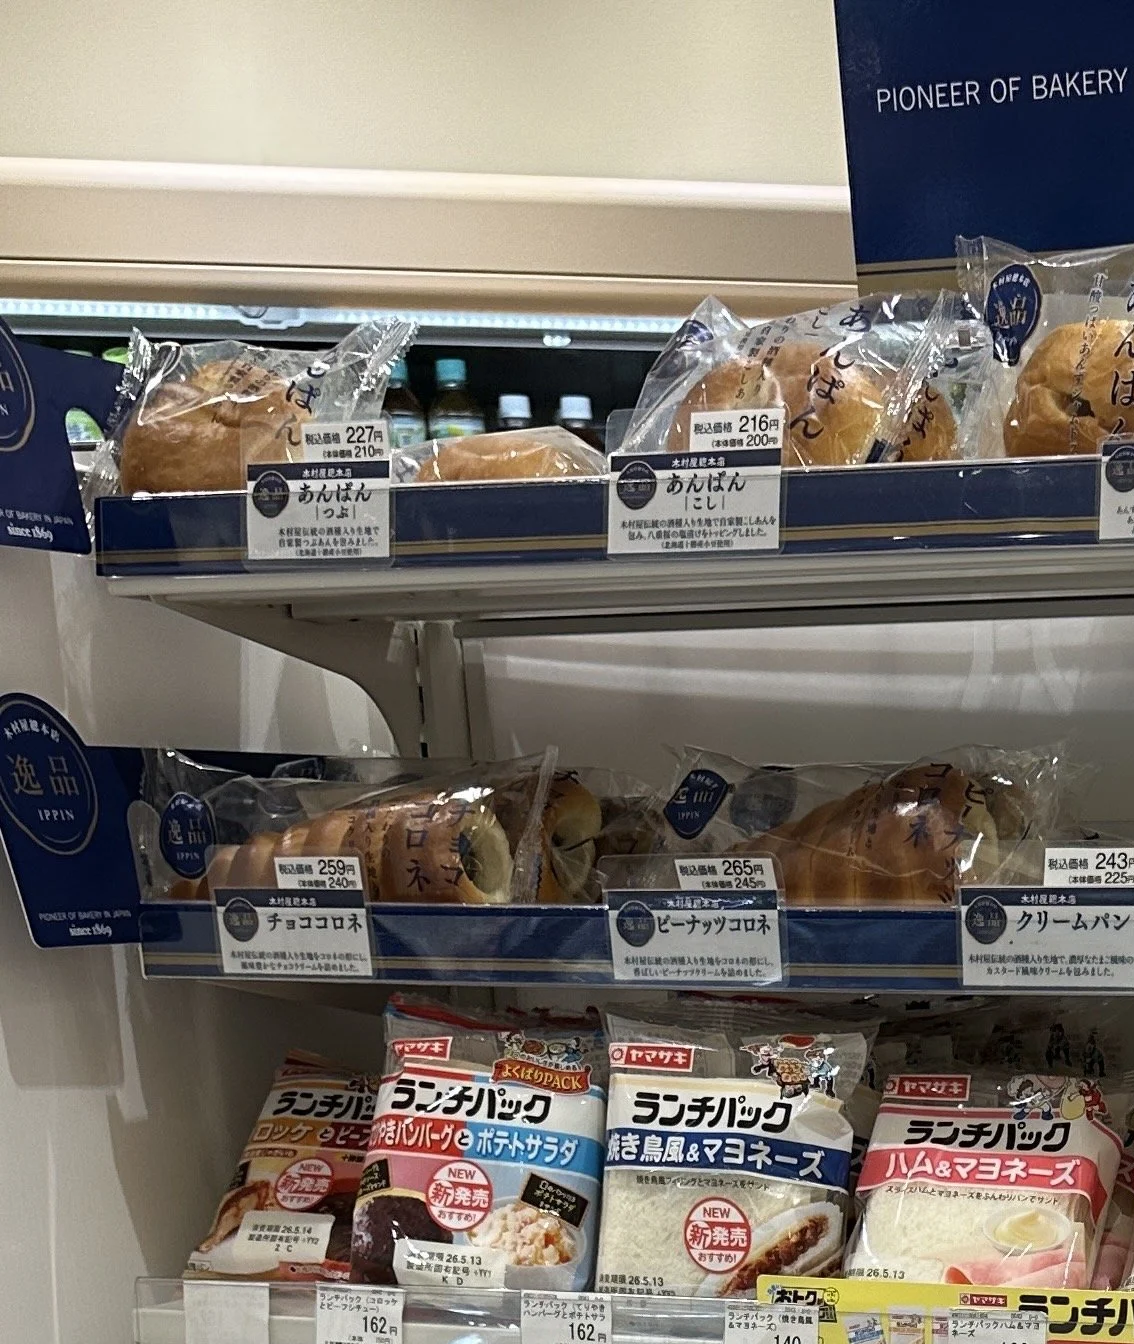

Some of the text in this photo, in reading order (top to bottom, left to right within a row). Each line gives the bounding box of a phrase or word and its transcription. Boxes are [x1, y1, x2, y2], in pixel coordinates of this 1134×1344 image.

[877, 81, 980, 112] PIONEER
[990, 78, 1020, 103] OF
[1032, 68, 1127, 101] BAKERY
[694, 414, 779, 434] 税込価格 216円
[305, 426, 384, 446] 税込価格 227円
[298, 482, 372, 504] あんぱん
[666, 472, 746, 494] あんぱん
[10, 754, 79, 797] 逸品
[679, 860, 764, 876] 税込価格 265円
[266, 913, 362, 932] チョココロネ
[657, 912, 771, 935] ピーナッツコロネ
[1016, 912, 1130, 933] クリームパン
[393, 1079, 550, 1123] ランチパック
[633, 1093, 791, 1133] ランチパック
[477, 1129, 577, 1164] ポテトサラダ
[904, 1119, 1069, 1151] ランチパック
[448, 1167, 476, 1180] NEW
[887, 1151, 1081, 1186] ハム&マヨネーズ
[431, 1182, 490, 1208] 新発売
[688, 1222, 748, 1248] 新発売
[362, 1316, 397, 1335] 162円
